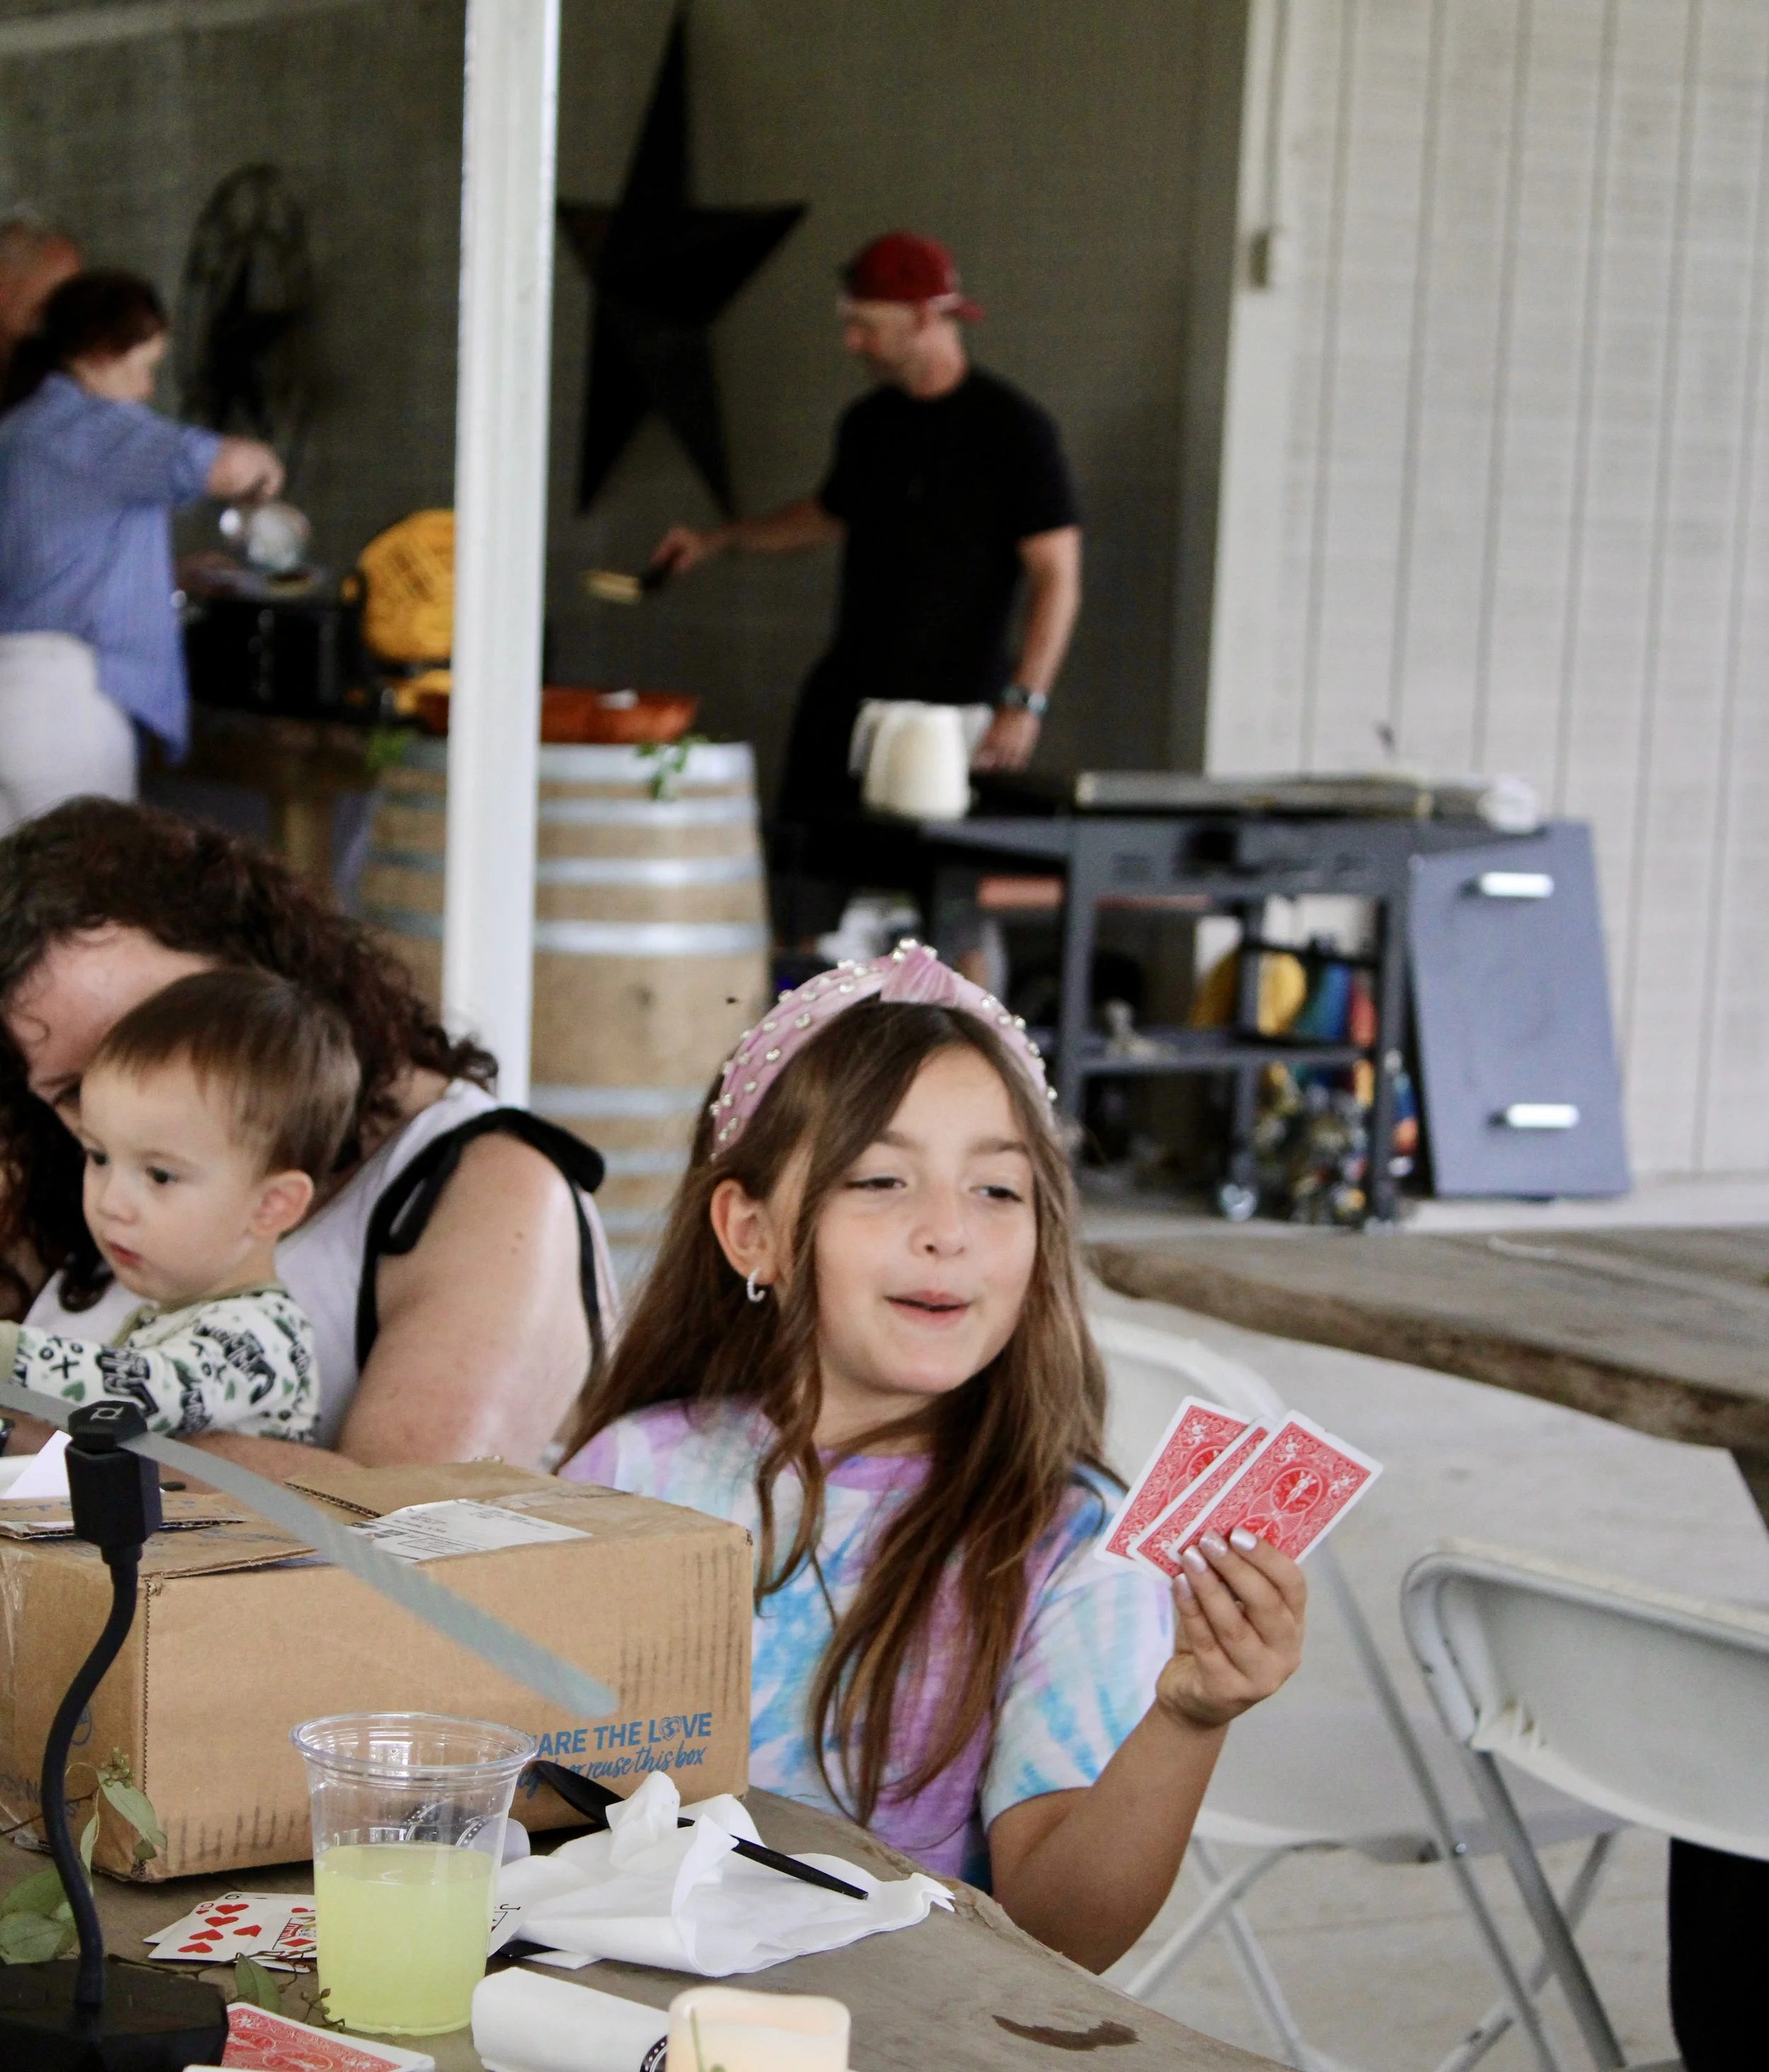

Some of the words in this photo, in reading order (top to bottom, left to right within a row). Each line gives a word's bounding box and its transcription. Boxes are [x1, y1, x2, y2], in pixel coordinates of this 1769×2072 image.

[532, 1729, 588, 1759] ARE
[593, 1721, 643, 1751] THE
[586, 1756, 633, 1779] reuse
[633, 1743, 674, 1773] this
[674, 1740, 708, 1769] box
